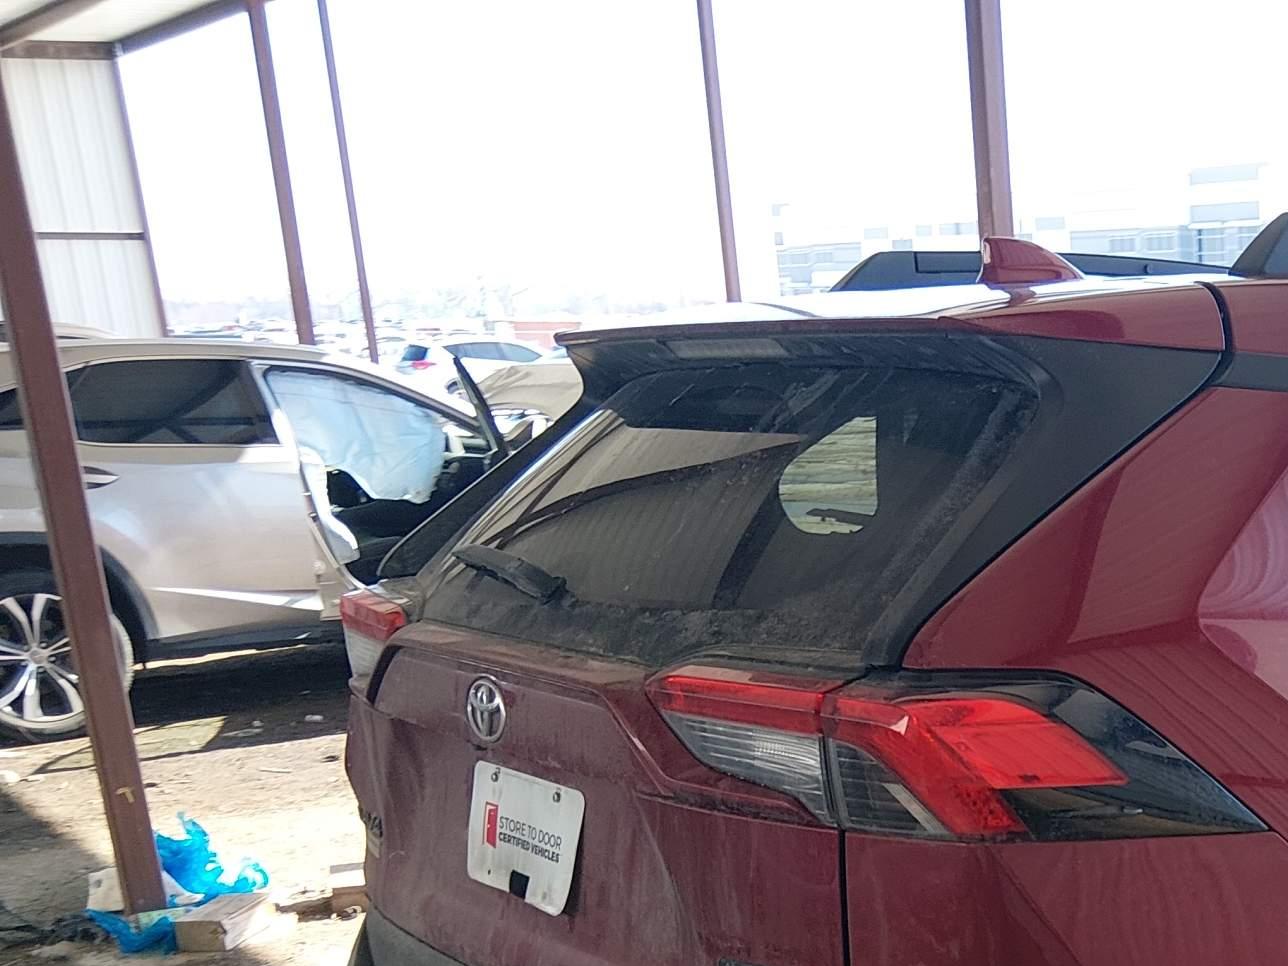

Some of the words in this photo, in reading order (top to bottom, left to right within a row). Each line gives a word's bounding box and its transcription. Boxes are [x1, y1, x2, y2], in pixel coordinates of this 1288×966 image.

[498, 831, 530, 851] CERTIFIED
[531, 843, 560, 863] VEHICLES
[499, 816, 526, 836] STORE
[528, 825, 537, 841] TO
[538, 829, 562, 851] DOOR
